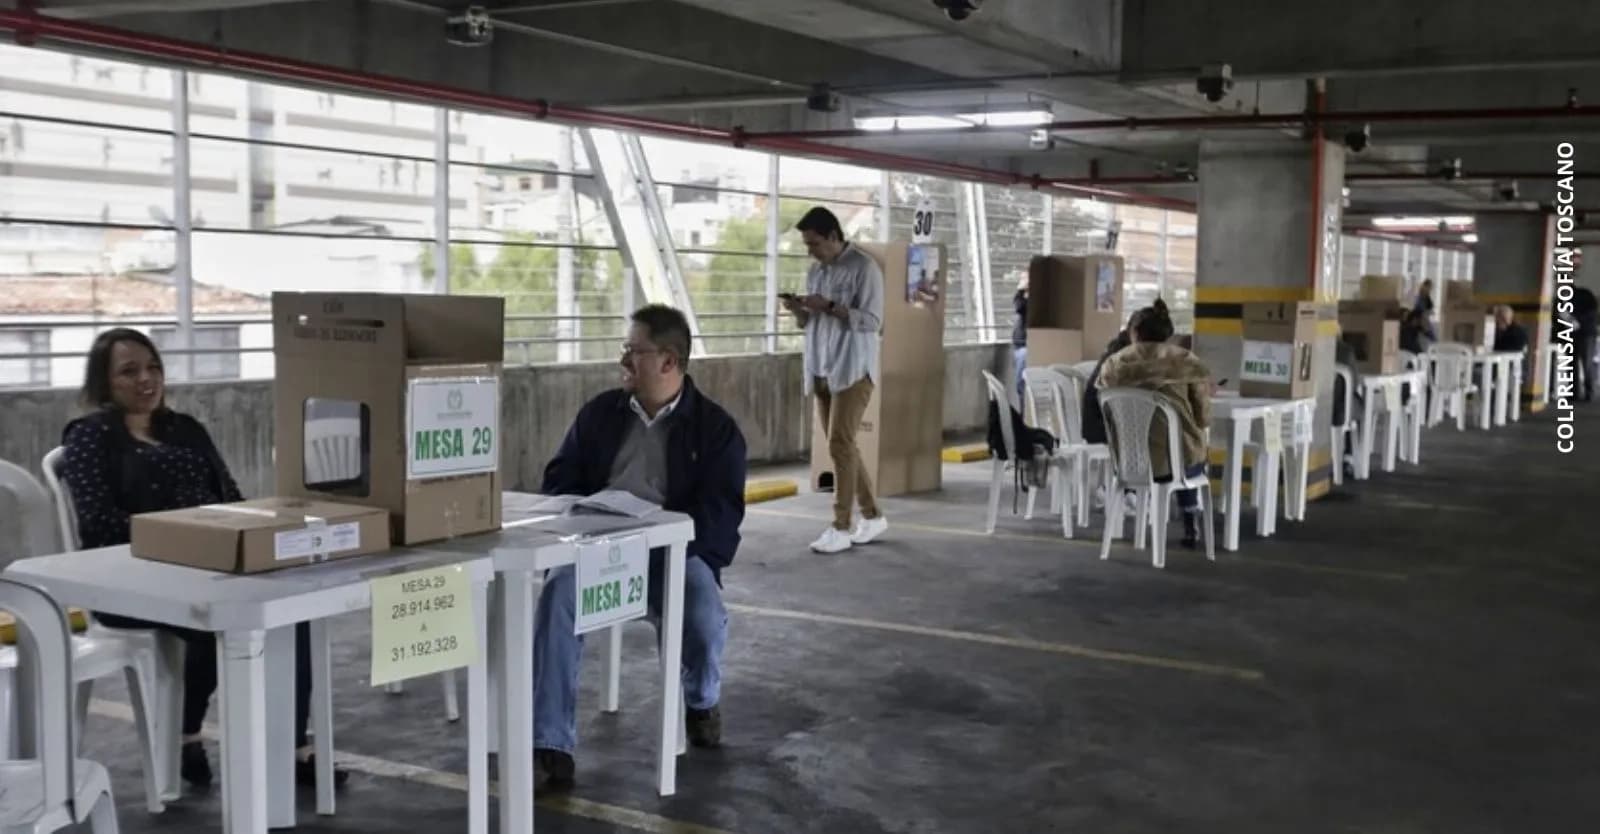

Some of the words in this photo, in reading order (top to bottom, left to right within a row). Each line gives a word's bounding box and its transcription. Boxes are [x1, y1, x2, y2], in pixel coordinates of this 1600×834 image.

[914, 210, 933, 236] 30
[1244, 360, 1272, 375] MESA
[415, 428, 464, 461] MESA
[472, 426, 492, 456] 29
[401, 579, 432, 593] MESA
[433, 576, 446, 589] 29
[582, 580, 621, 616] MESA
[627, 575, 643, 604] 29
